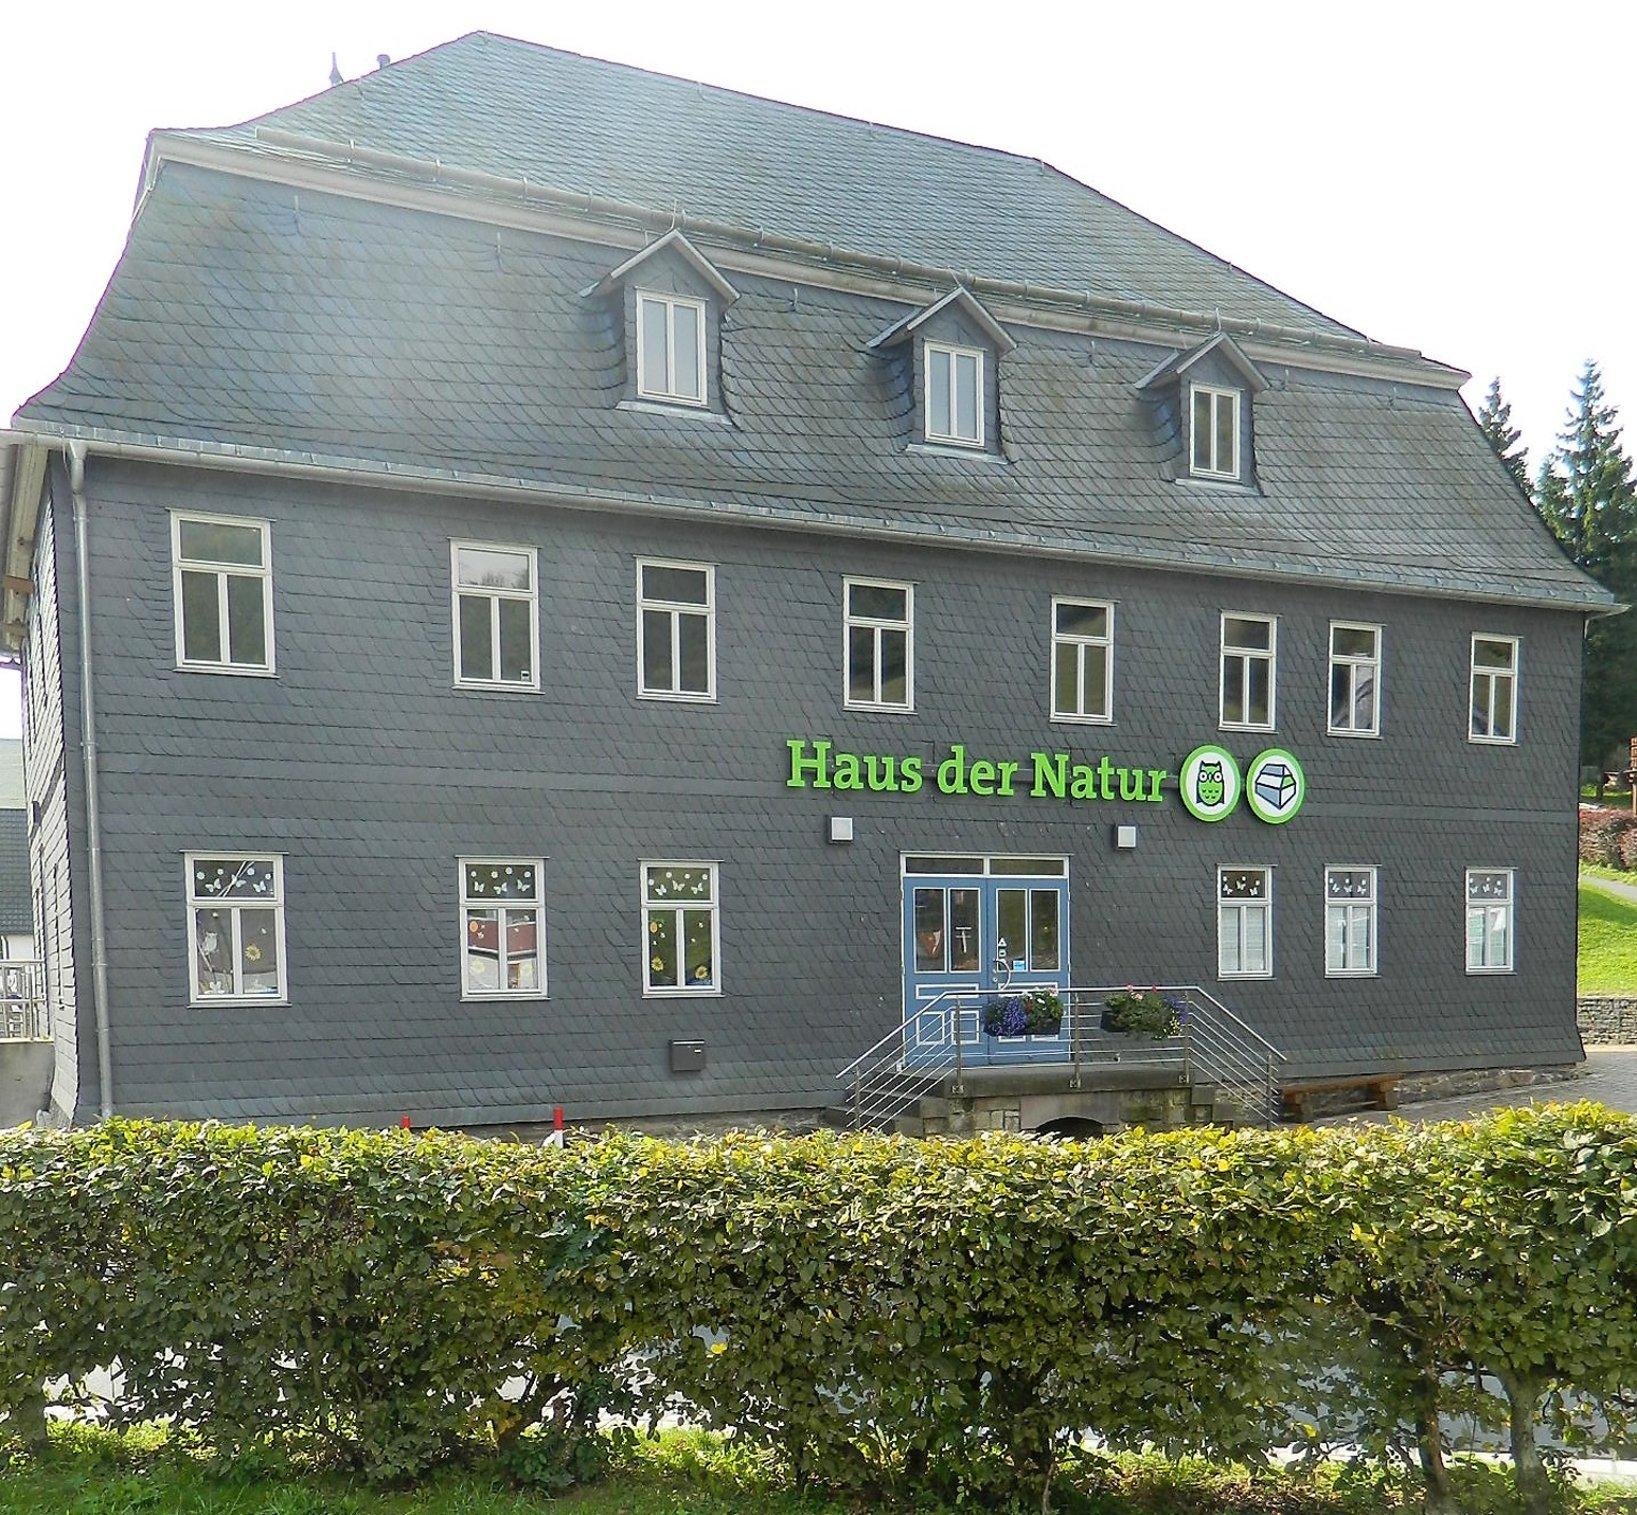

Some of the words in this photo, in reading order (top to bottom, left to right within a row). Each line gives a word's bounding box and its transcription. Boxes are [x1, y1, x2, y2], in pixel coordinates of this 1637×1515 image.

[786, 740, 923, 792] Haus
[936, 745, 1018, 797] der
[1030, 752, 1167, 803] Natur
